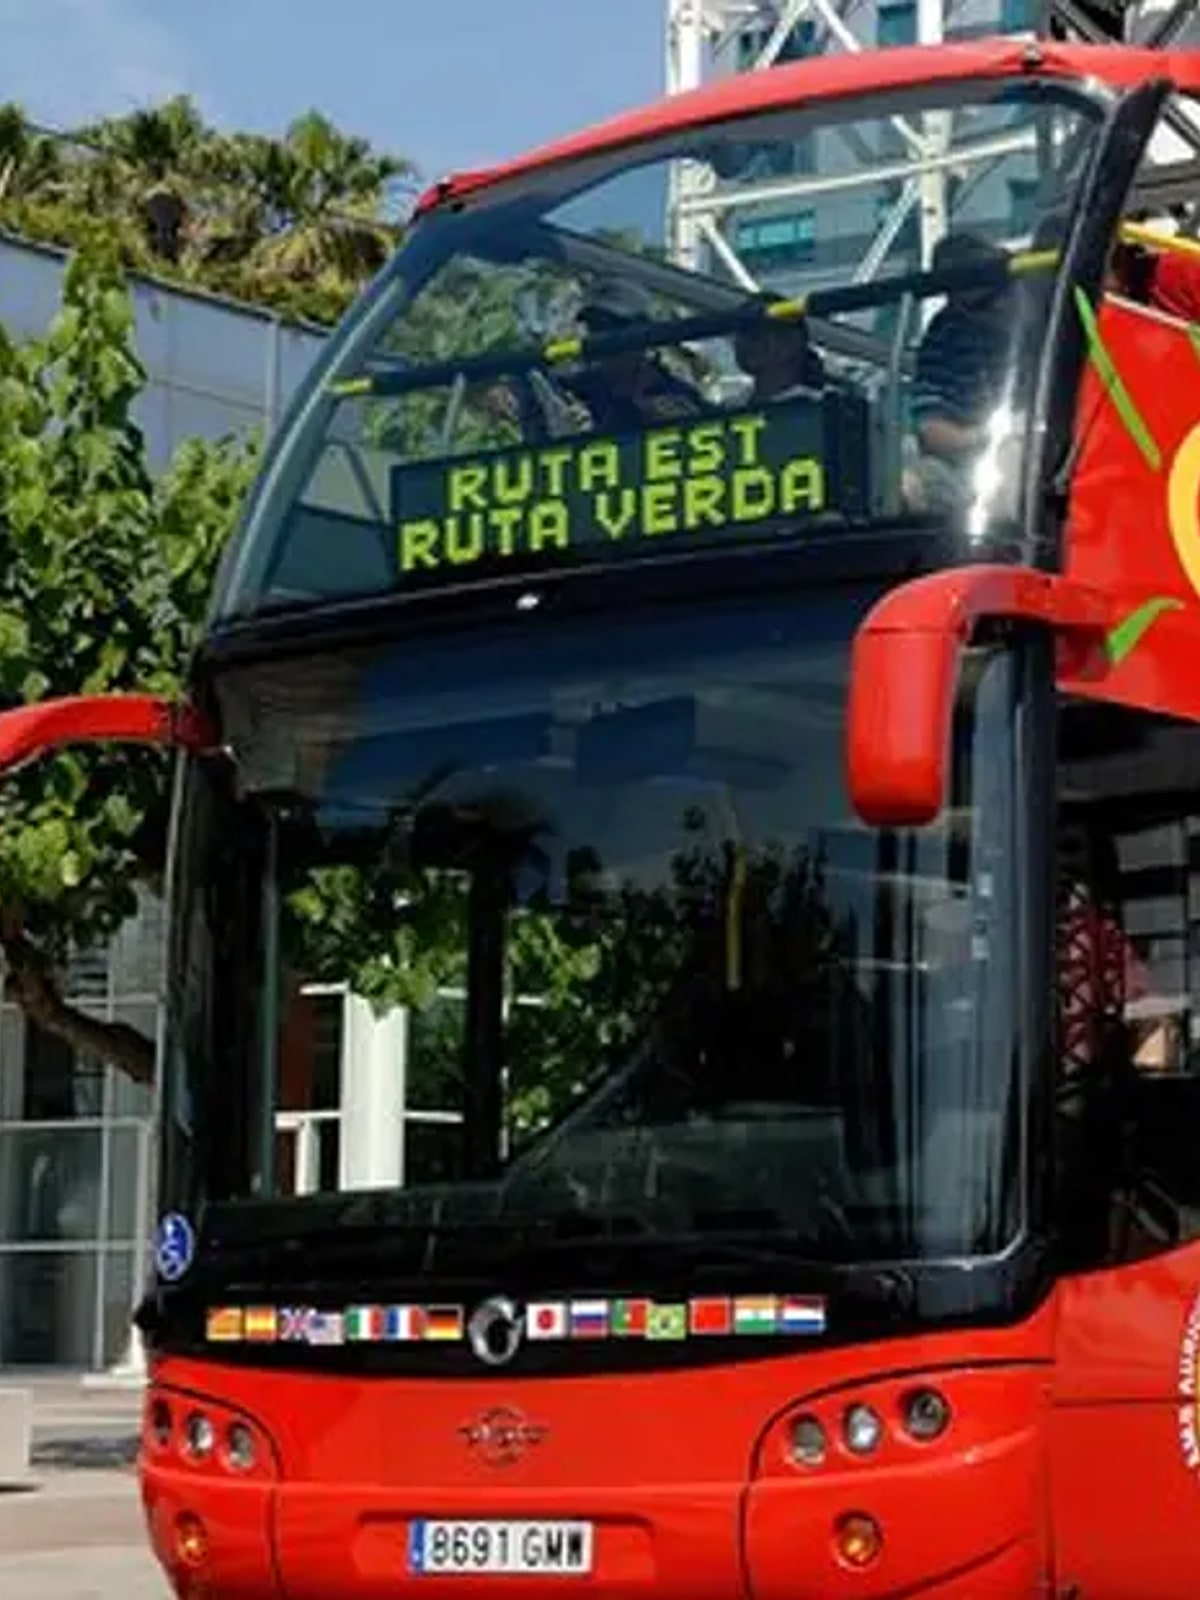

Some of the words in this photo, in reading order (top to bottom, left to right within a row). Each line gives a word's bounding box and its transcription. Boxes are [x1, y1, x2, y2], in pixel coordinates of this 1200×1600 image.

[449, 442, 619, 510] RUTA
[645, 414, 766, 480] EST
[401, 501, 569, 571] RUTA
[596, 458, 825, 539] VERDA
[431, 1526, 509, 1567] 8691
[521, 1526, 583, 1568] GMW
